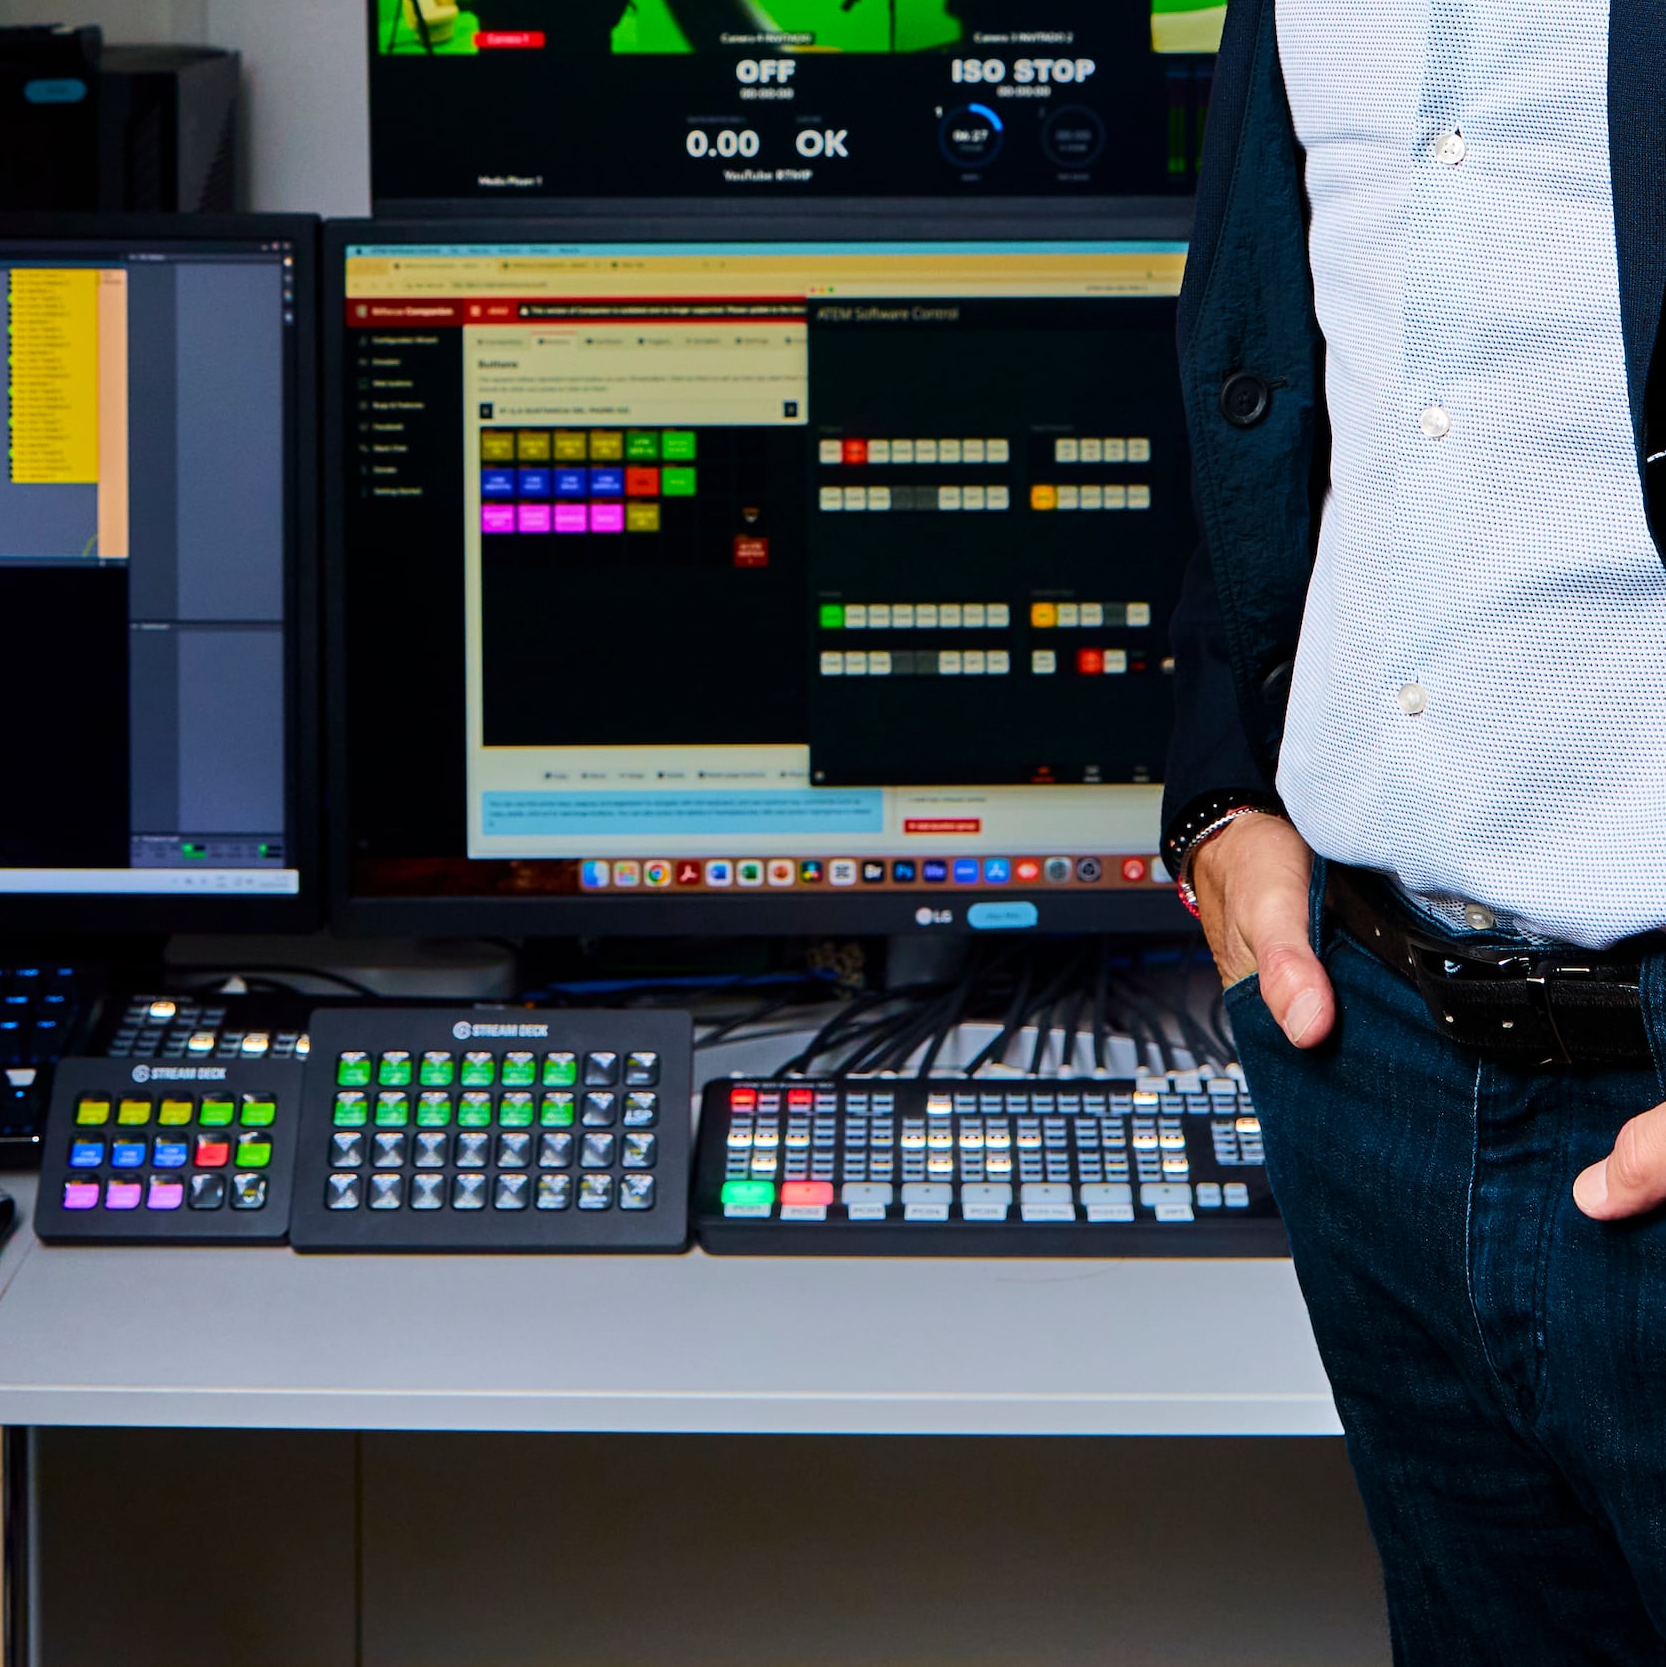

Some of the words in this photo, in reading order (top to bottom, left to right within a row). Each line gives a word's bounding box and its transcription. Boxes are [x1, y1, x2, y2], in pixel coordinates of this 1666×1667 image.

[735, 59, 797, 84] OFF
[951, 58, 1006, 84] ISO
[1013, 58, 1096, 84] STOP
[685, 129, 760, 158] 0.00
[795, 129, 849, 158] OK
[724, 168, 774, 183] YouTube
[816, 306, 852, 321] ATEM
[854, 305, 909, 321] Software
[911, 305, 960, 321] Control
[932, 909, 953, 924] LG
[470, 1023, 518, 1037] STREAM
[518, 1023, 549, 1037] DECK
[150, 1066, 196, 1080] STREAM
[197, 1067, 227, 1080] DECK
